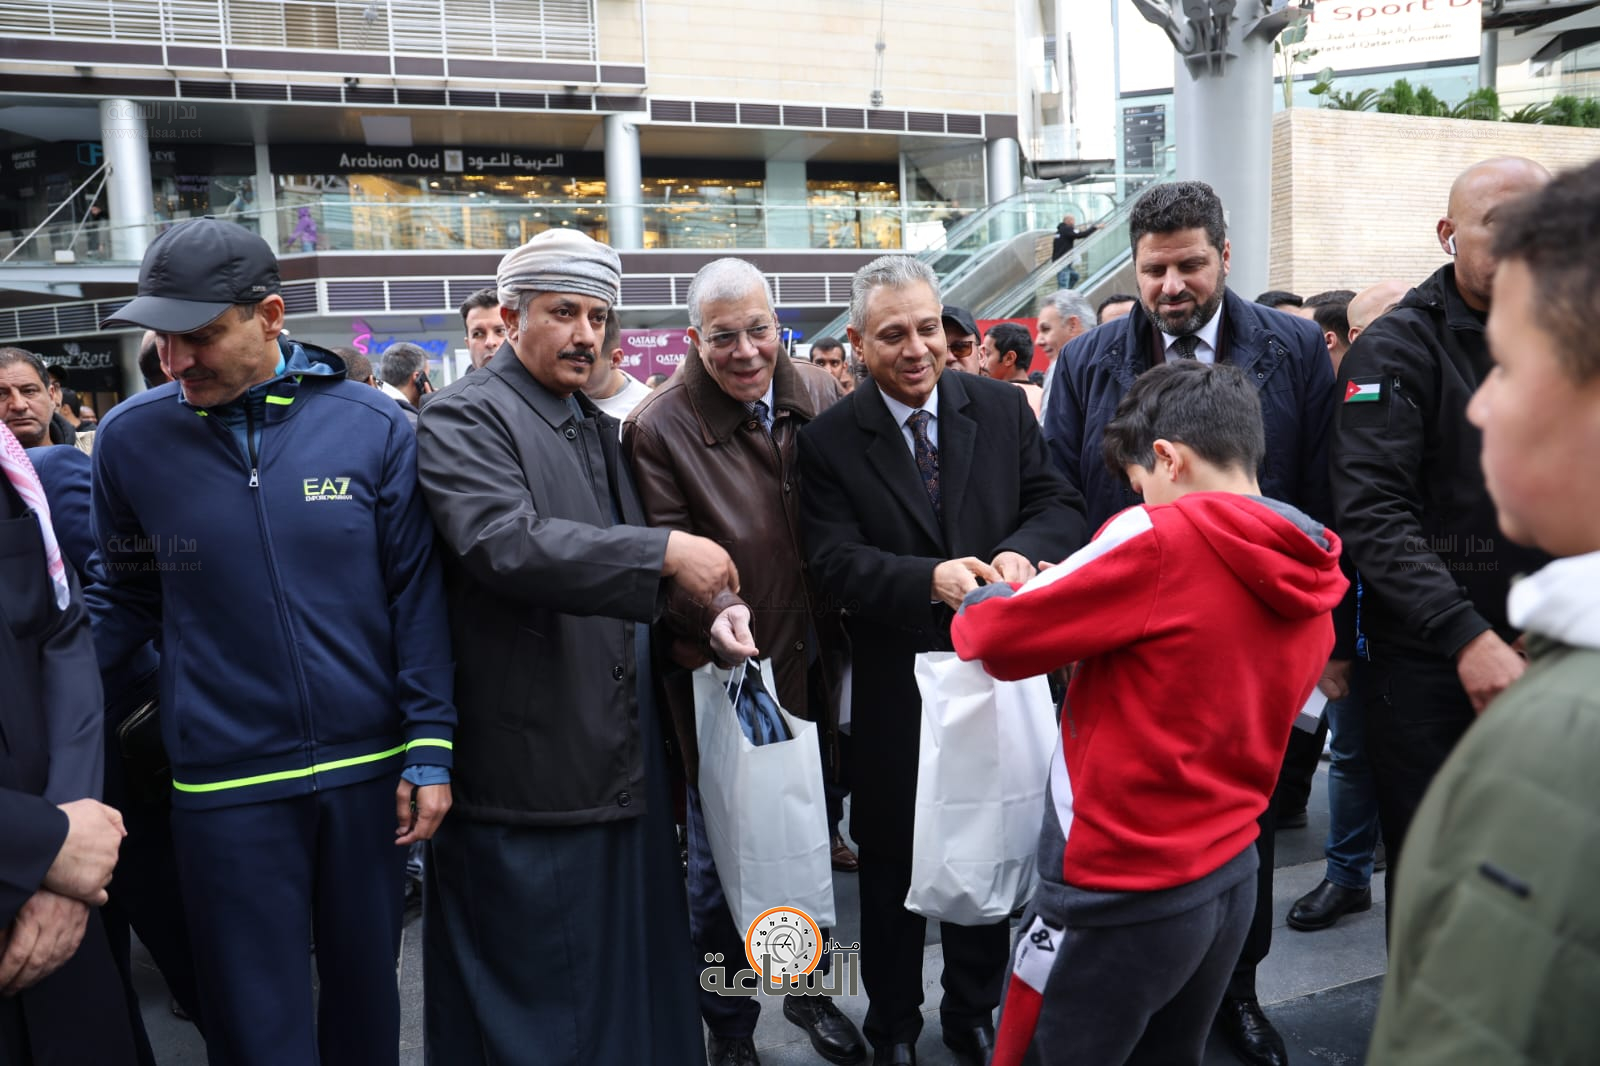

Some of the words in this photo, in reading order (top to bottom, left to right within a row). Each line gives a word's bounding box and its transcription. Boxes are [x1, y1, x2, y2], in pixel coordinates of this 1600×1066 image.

[1333, 0, 1433, 21] Sport
[339, 153, 402, 168] Arabian
[408, 153, 439, 168] Oud
[468, 153, 510, 170] للعود
[513, 153, 564, 171] العربية
[627, 336, 657, 347] QATAR
[79, 350, 112, 365] Roti
[304, 477, 351, 495] EA7
[1031, 929, 1055, 952] 87
